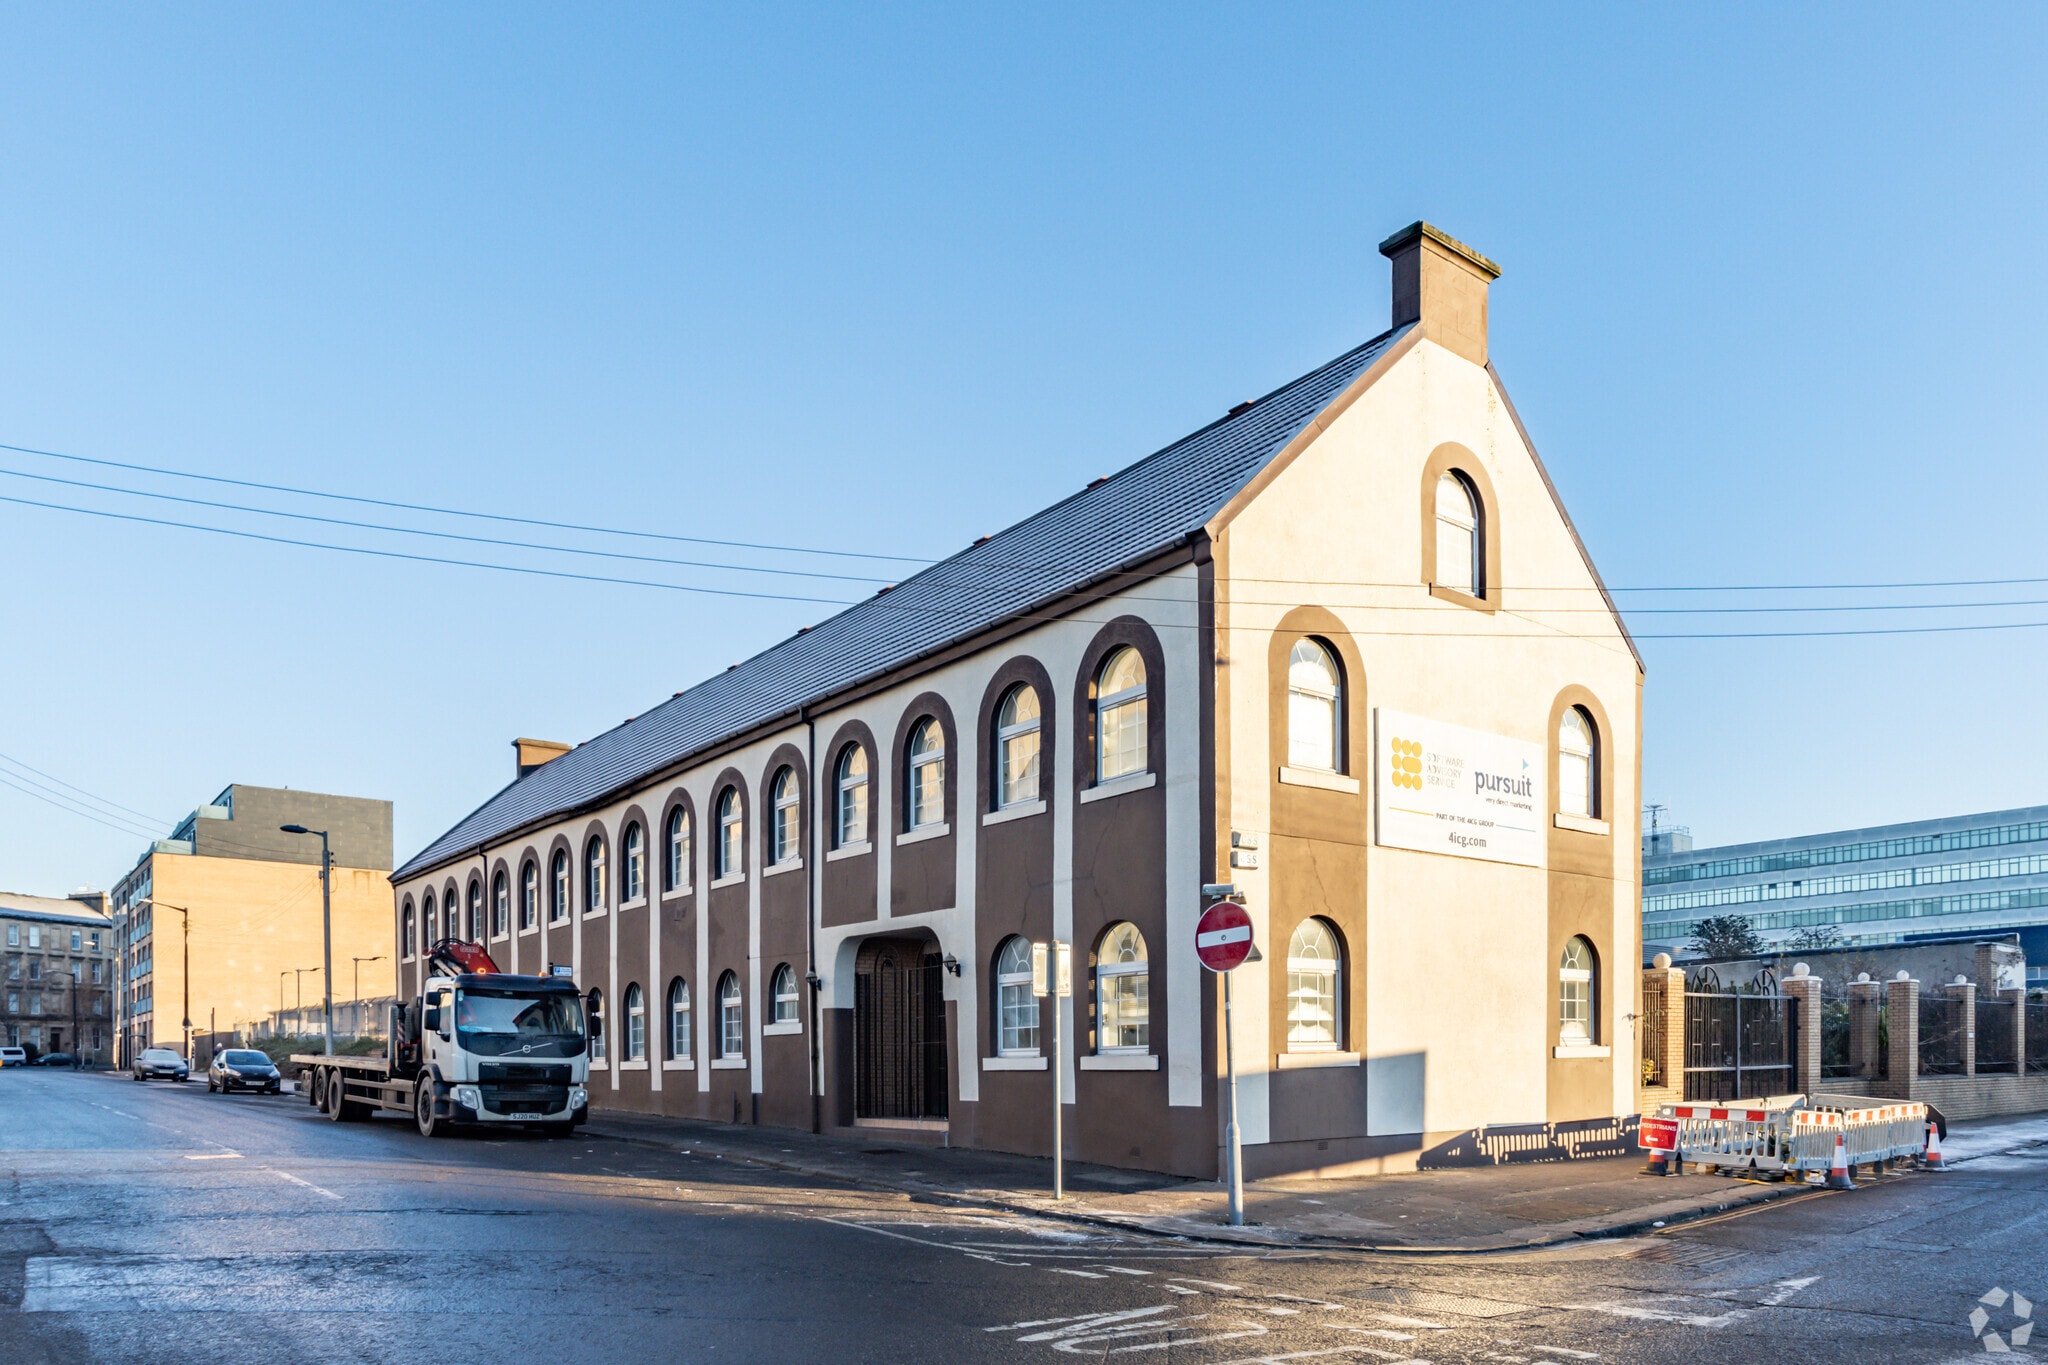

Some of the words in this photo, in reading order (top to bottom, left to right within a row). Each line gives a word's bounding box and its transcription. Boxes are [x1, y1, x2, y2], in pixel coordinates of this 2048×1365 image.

[1475, 771, 1532, 797] pursuit
[1436, 812, 1448, 820] PART
[1479, 819, 1495, 828] GROUP
[1449, 832, 1487, 848] 4icg.com
[1642, 1122, 1677, 1132] PEDESTRIANS
